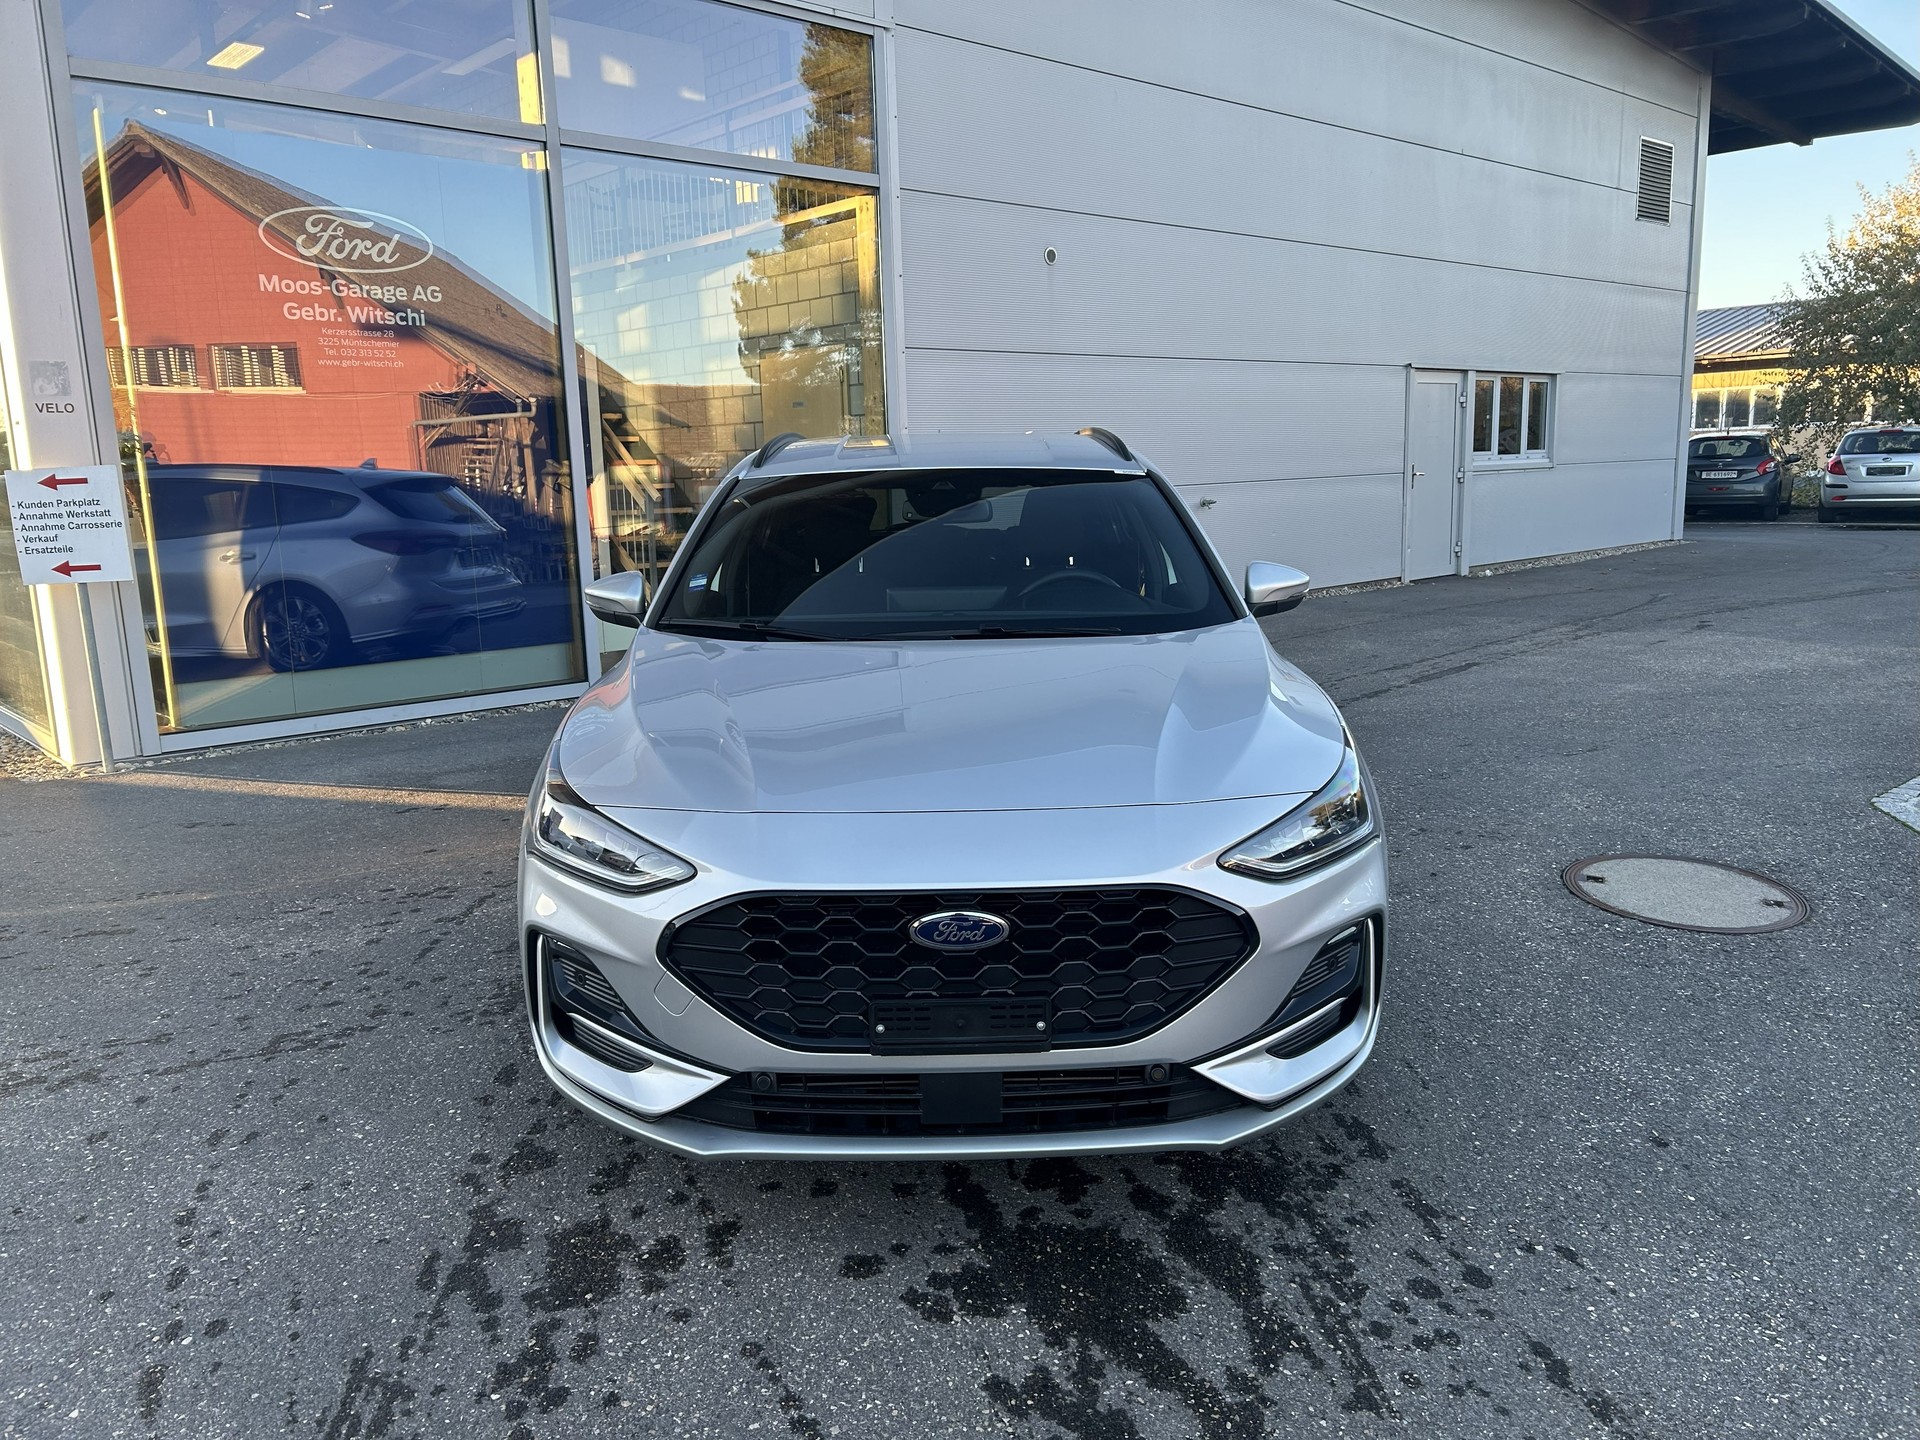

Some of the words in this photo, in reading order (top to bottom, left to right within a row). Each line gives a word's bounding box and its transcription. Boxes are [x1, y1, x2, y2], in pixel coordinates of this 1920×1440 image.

[296, 213, 401, 264] Ford
[258, 273, 408, 304] Moos-Garage
[411, 284, 442, 303] AG
[283, 302, 343, 323] Gebr.
[346, 305, 427, 327] Witschi
[321, 327, 382, 338] Kerzersstrasse
[383, 329, 395, 338] 28
[317, 337, 340, 346] 3225
[341, 338, 400, 348] Müntschemier
[323, 347, 339, 356] Tel.
[340, 348, 357, 357] 032
[358, 349, 373, 357] 313
[373, 349, 384, 358] 52
[385, 350, 397, 358] 52
[317, 358, 404, 368] www.gebr-witschi.ch
[34, 402, 75, 414] VELO
[17, 500, 54, 509] Kunden
[56, 498, 101, 509] Parkplatz
[18, 511, 64, 521] Annahme
[65, 508, 112, 519] Werkstatt
[20, 522, 66, 532] Annahme
[67, 519, 123, 531] Carrosserie
[22, 533, 59, 544] Verkauf
[24, 544, 74, 555] Ersatzteile
[933, 920, 986, 941] Ford
